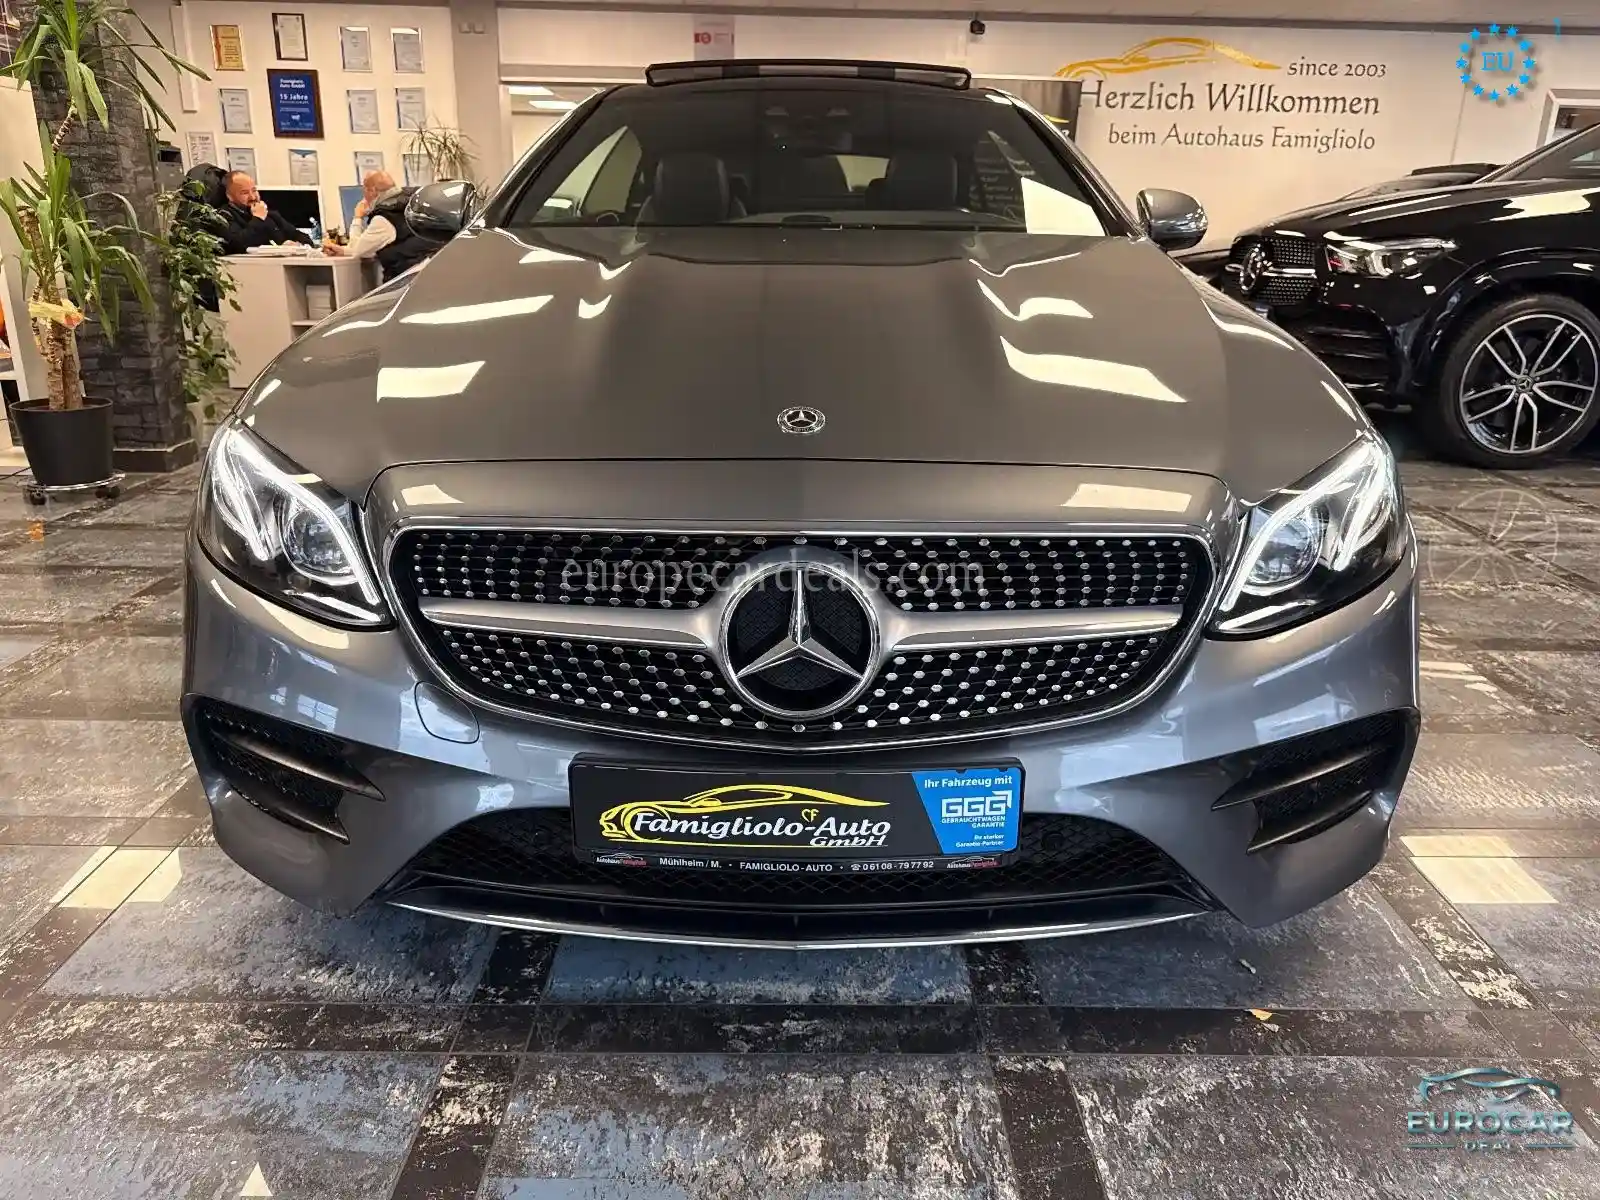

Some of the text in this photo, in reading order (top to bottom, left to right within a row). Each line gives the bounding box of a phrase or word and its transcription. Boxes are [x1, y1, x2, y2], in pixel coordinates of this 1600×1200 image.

[1287, 56, 1387, 77] since 2003
[1079, 79, 1380, 115] Herzlich Willkommen
[1109, 122, 1375, 153] beim Autohaus Famigliolo
[924, 775, 1013, 789] Ihr Fahrzeug mit
[941, 795, 1007, 818] GGG
[941, 816, 1006, 824] GEBRAUCHTWAGEN
[971, 821, 1005, 829] GARANTIE
[808, 834, 887, 847] GmbH
[659, 857, 704, 868] Mühlheim
